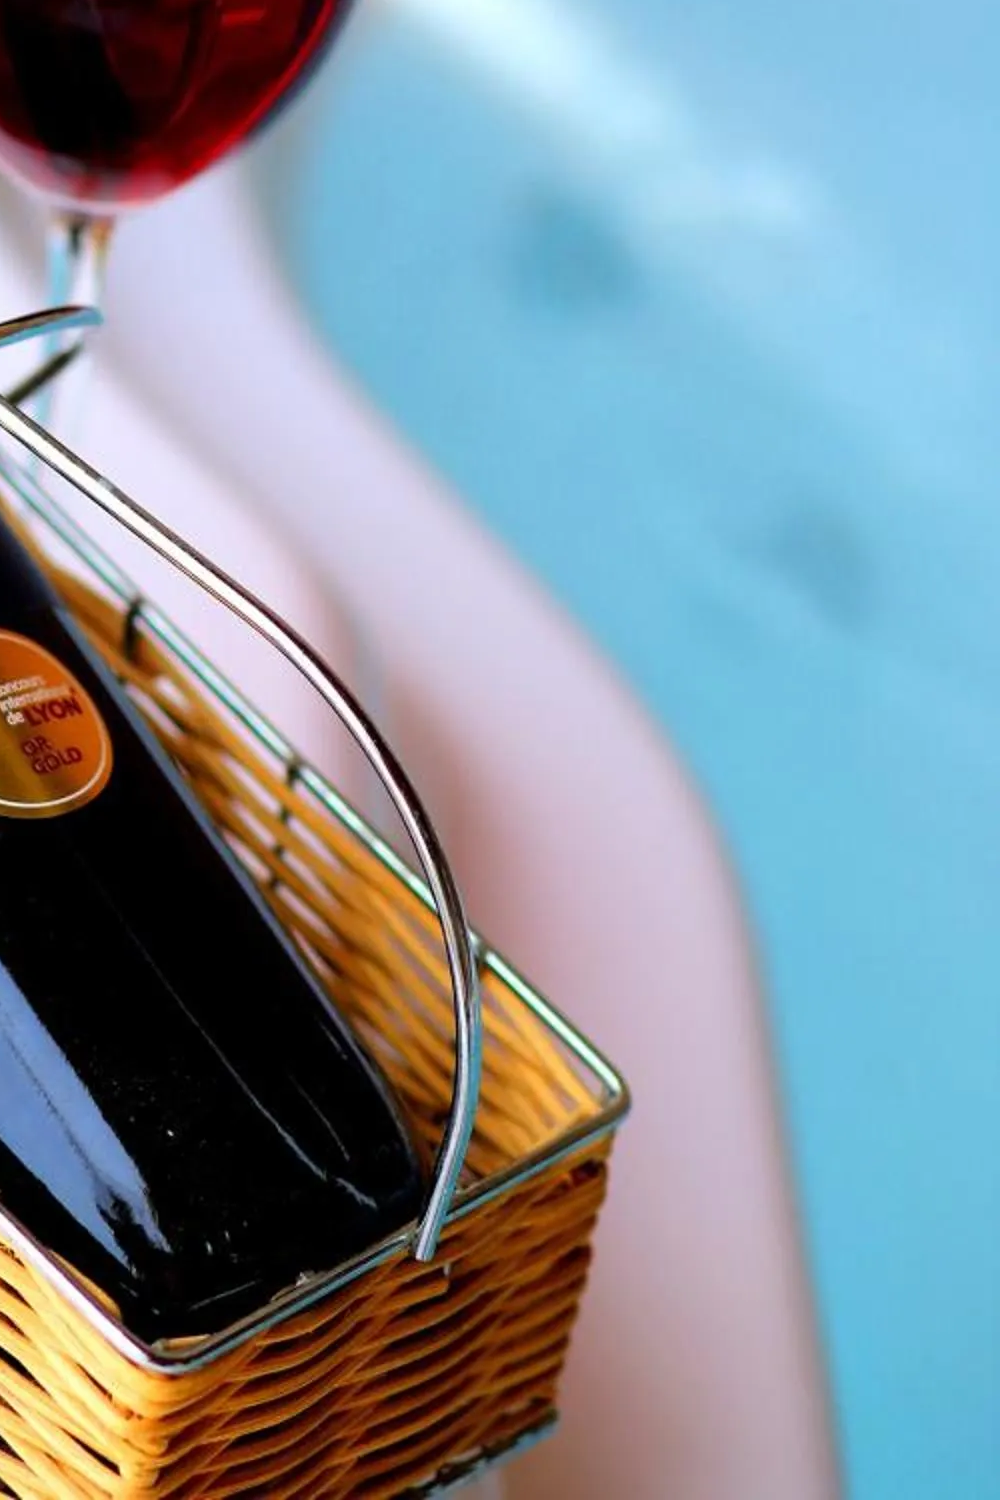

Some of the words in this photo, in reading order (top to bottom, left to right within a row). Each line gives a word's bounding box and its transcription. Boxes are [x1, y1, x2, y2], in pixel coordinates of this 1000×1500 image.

[5, 709, 25, 726] de
[23, 696, 84, 727] LYON
[32, 746, 84, 775] GOLD
